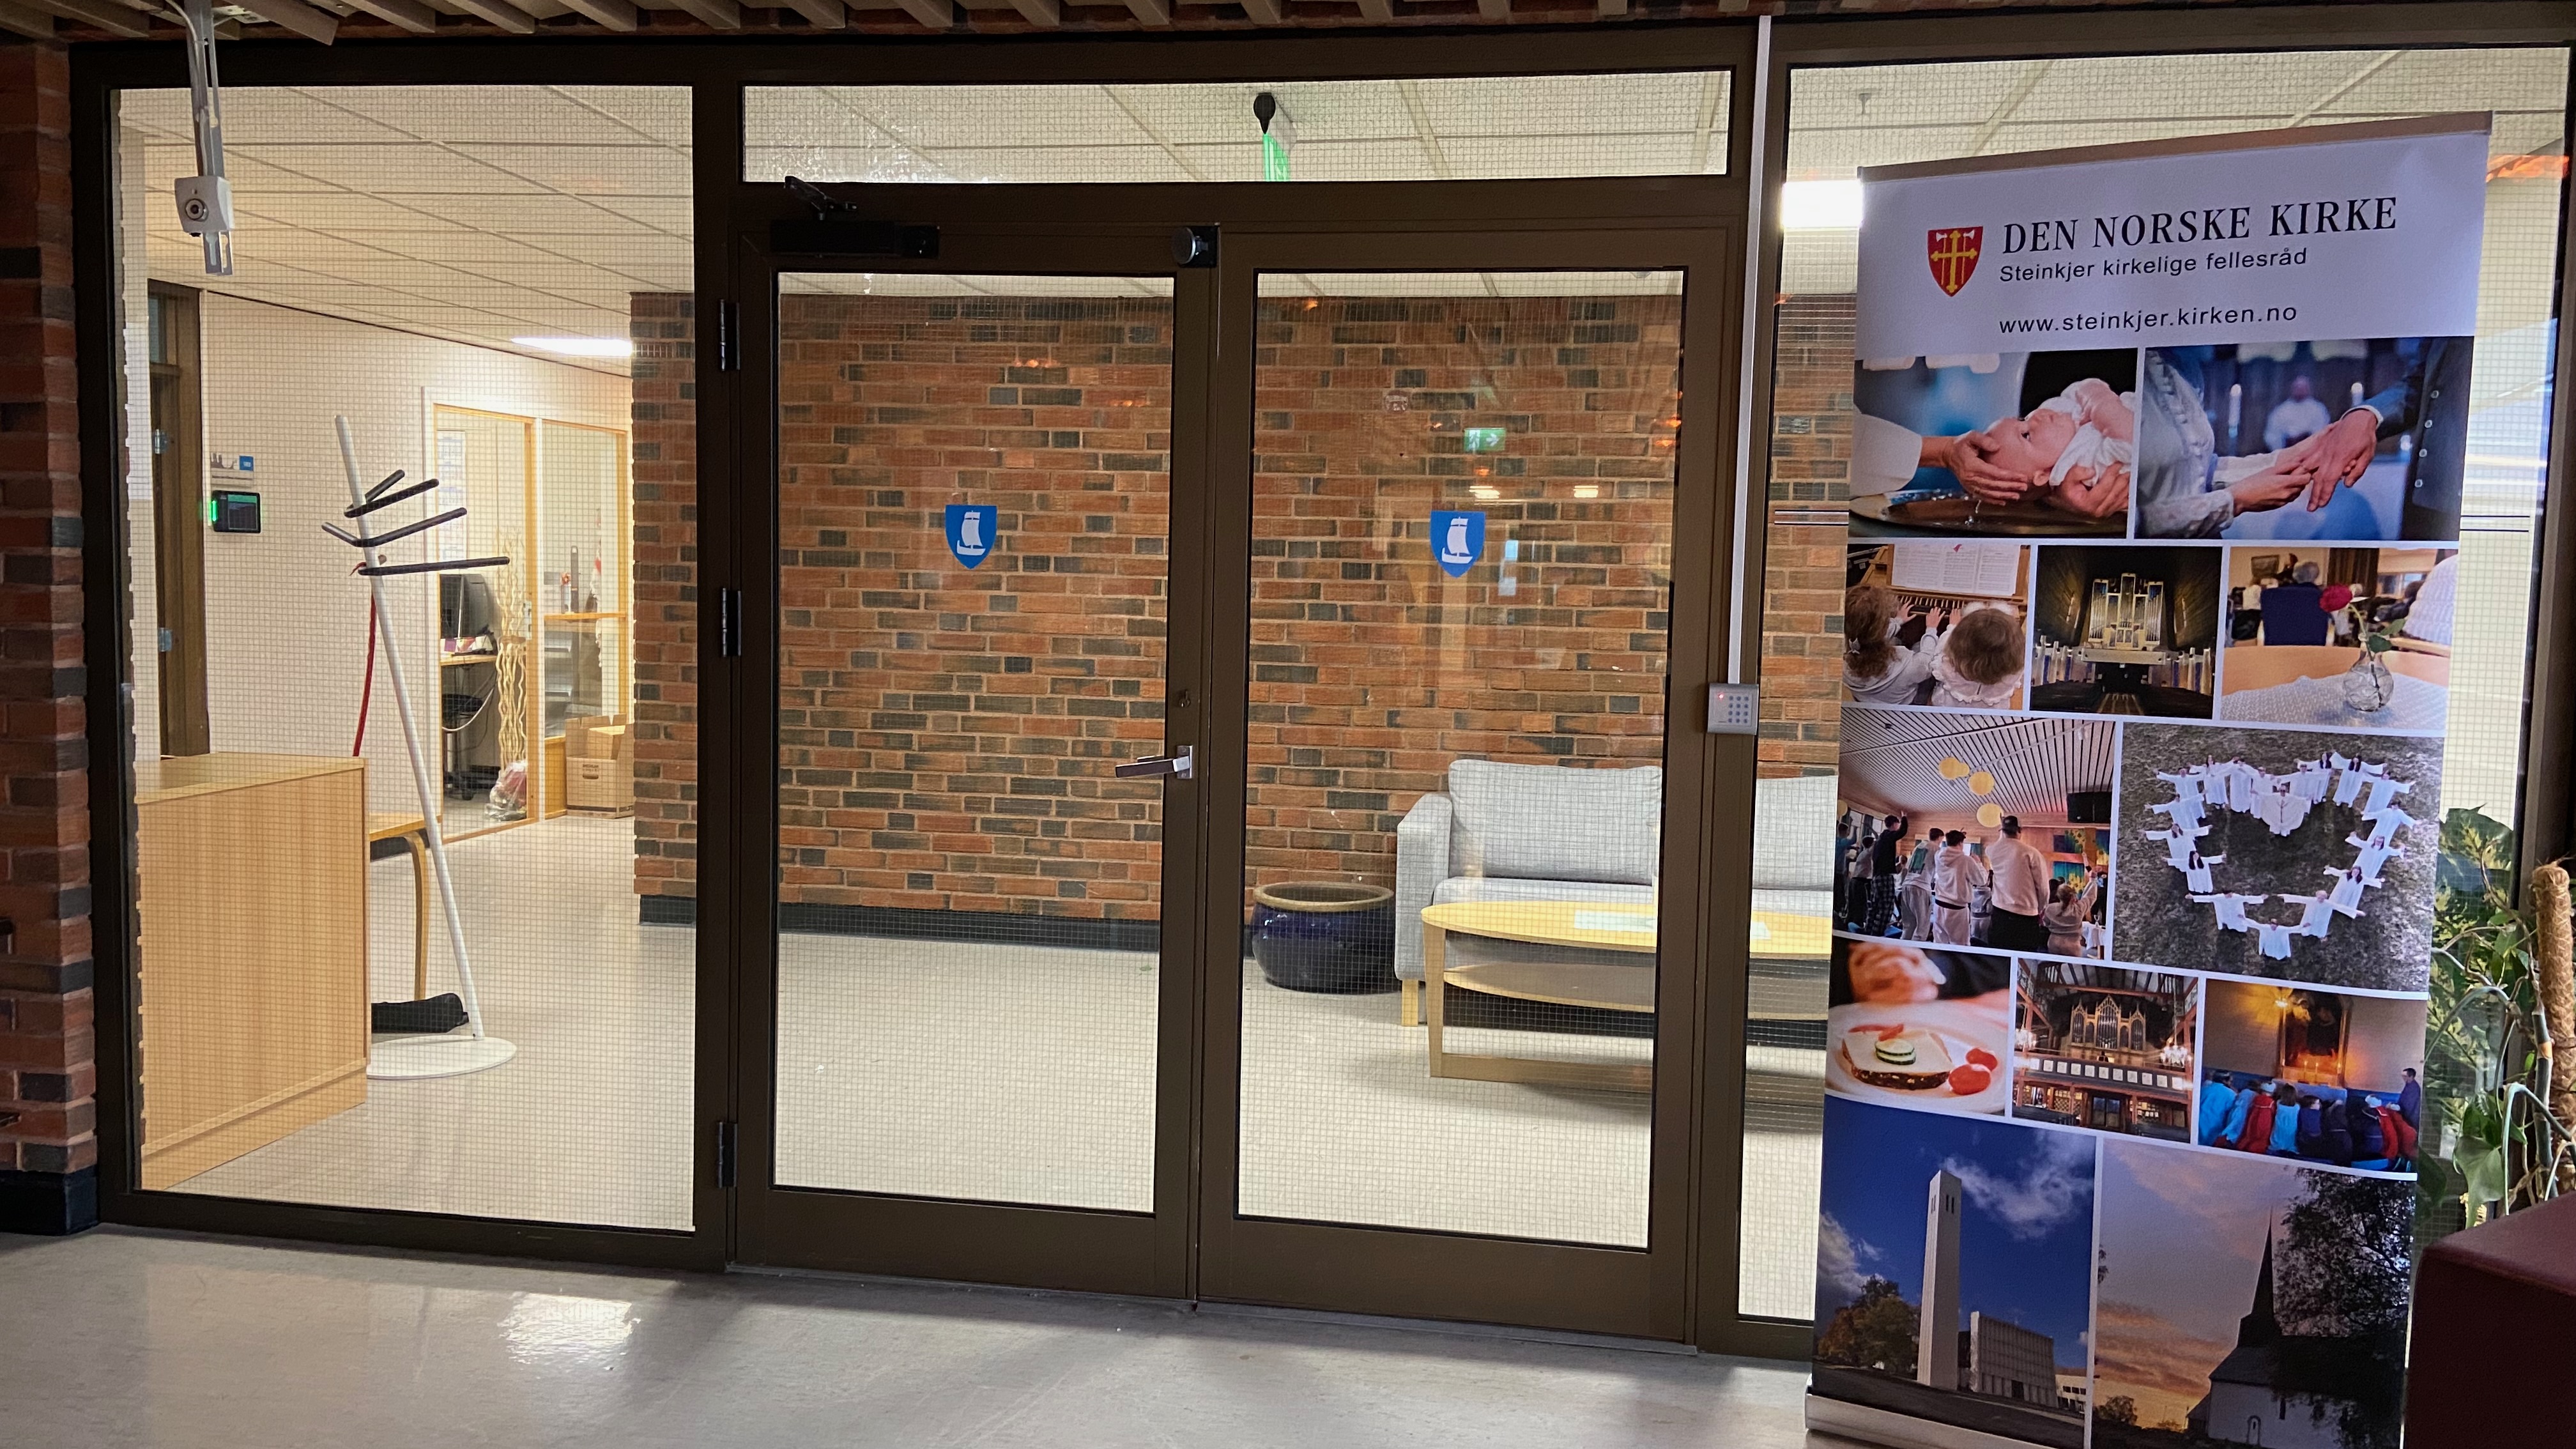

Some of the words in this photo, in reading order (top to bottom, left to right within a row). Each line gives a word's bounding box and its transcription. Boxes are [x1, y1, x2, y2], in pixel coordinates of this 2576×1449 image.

[2002, 218, 2079, 254] DEN
[2092, 206, 2250, 248] NORSKE
[2268, 197, 2396, 236] KIRKE
[1999, 263, 2095, 282] Steinkjer
[2103, 256, 2196, 276] kirkelige
[2205, 247, 2307, 270] fellesråd
[1999, 307, 2297, 333] www.steinkjer.kirken.no
